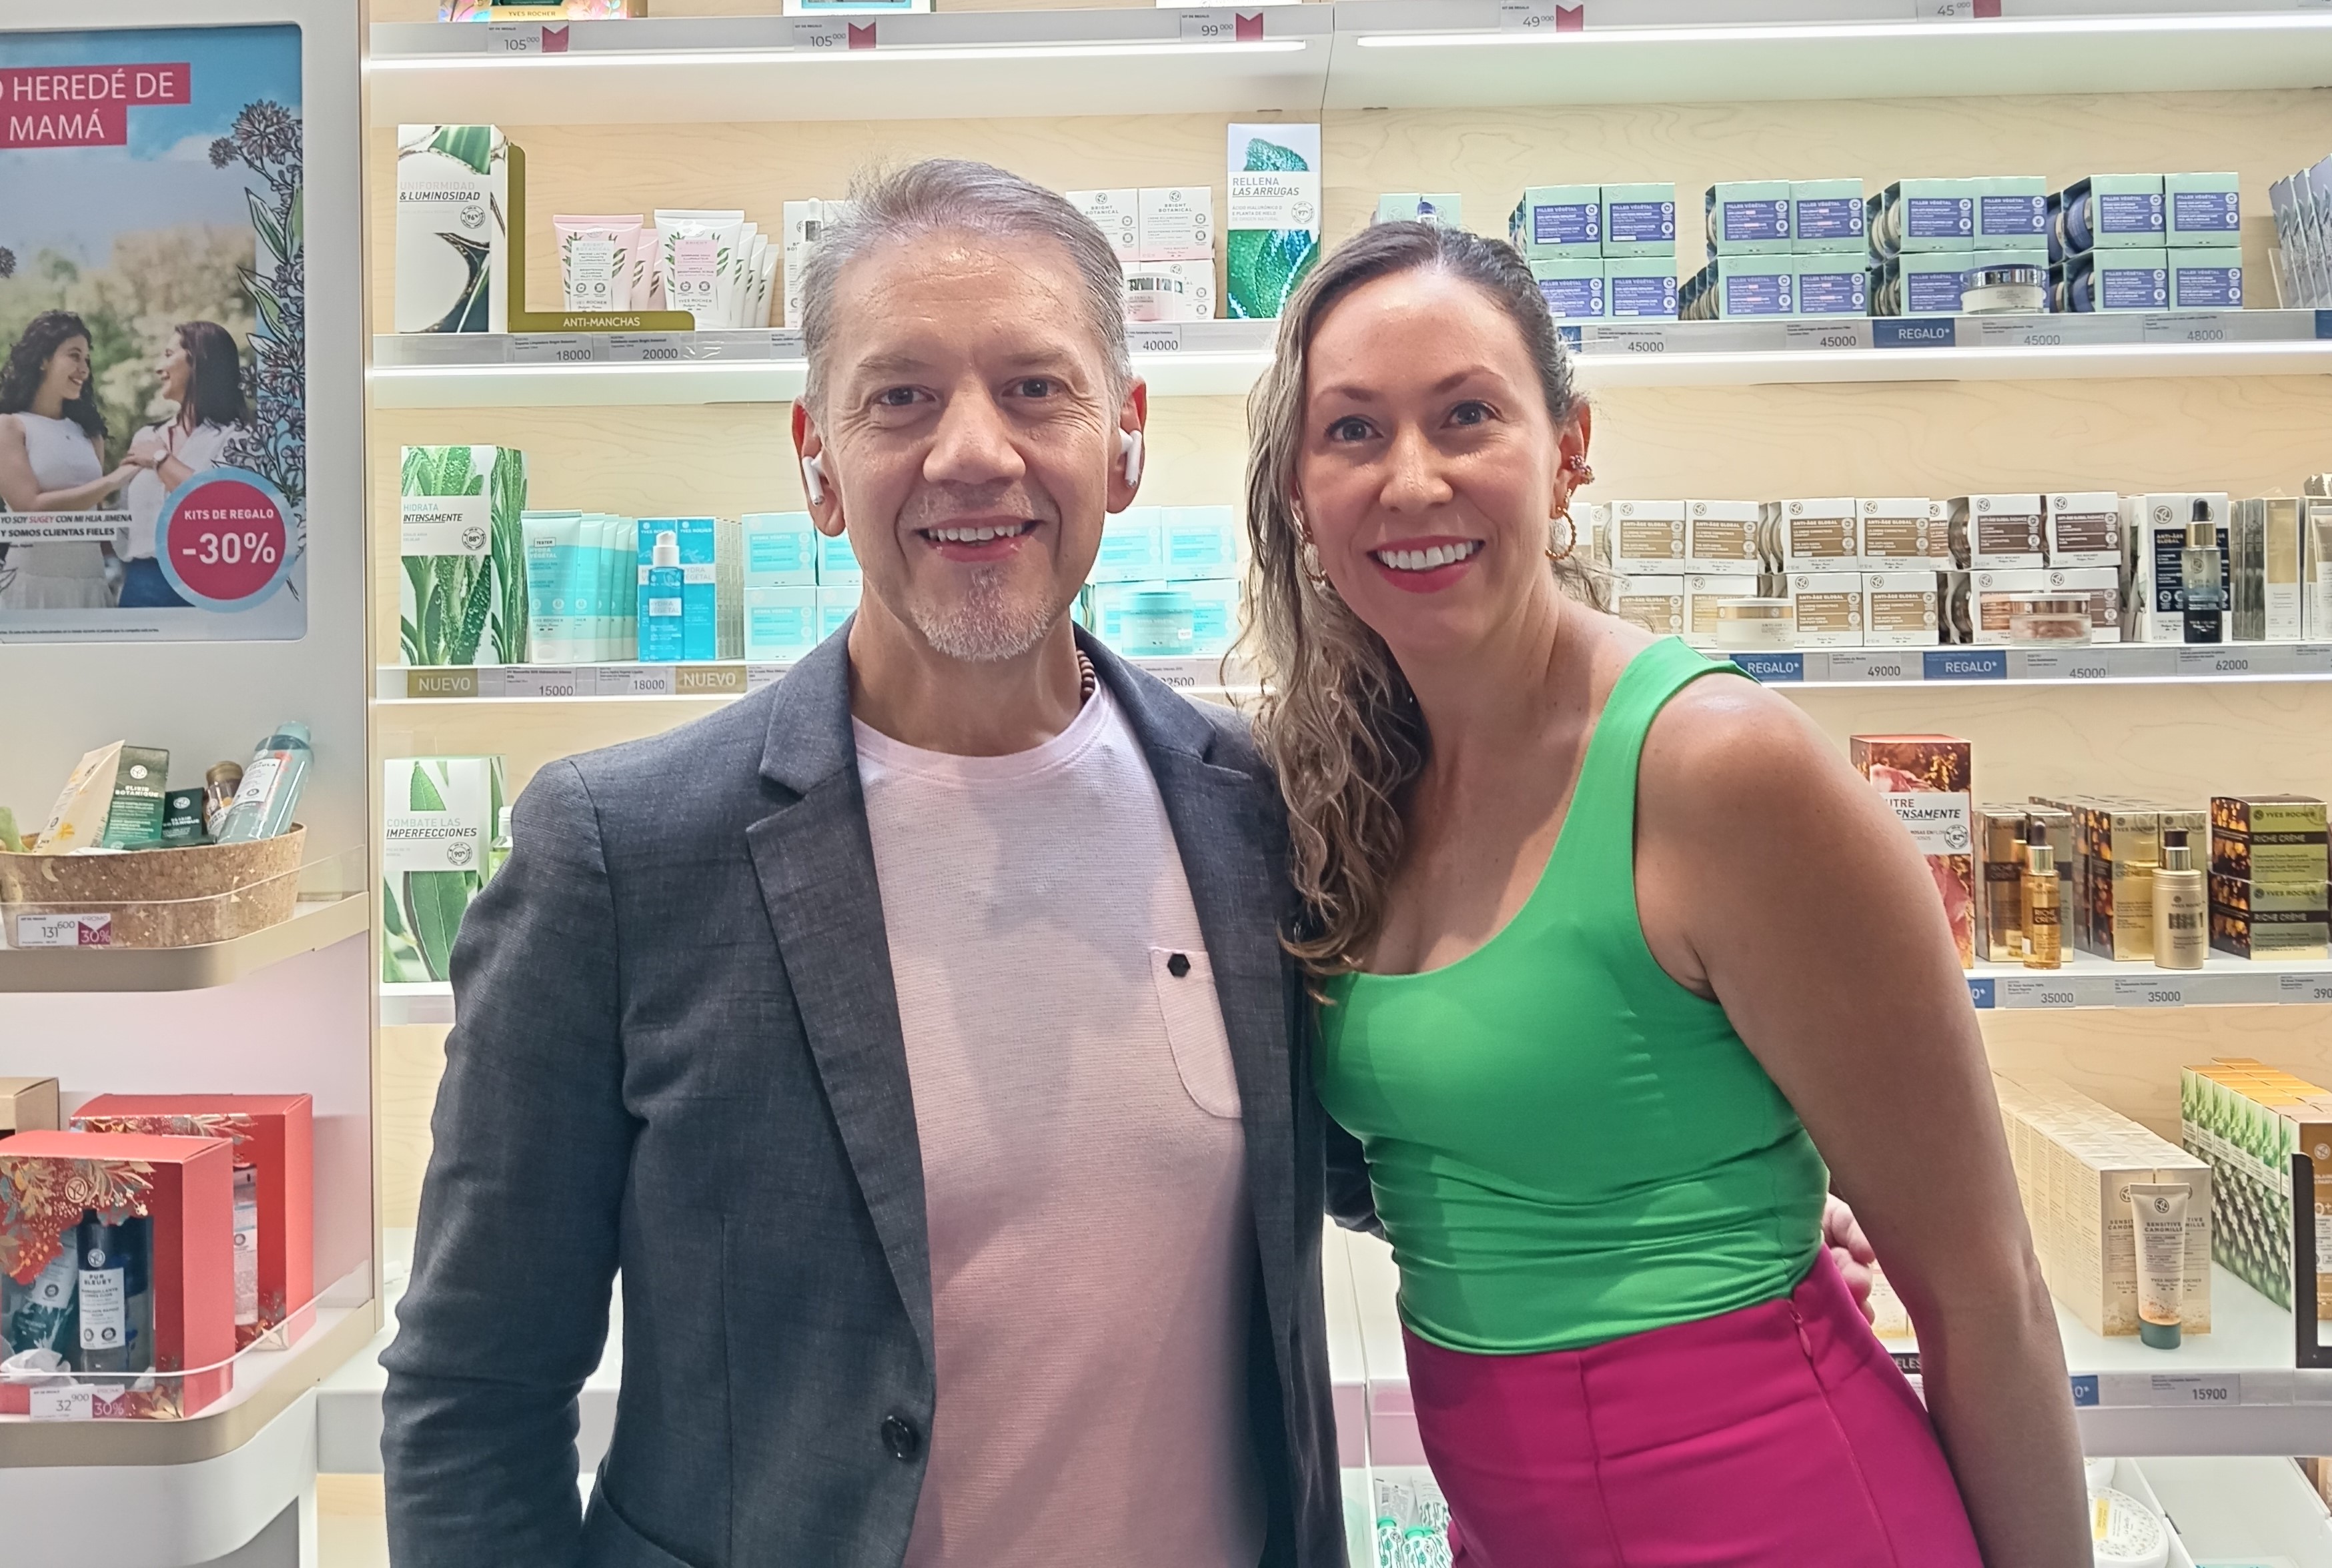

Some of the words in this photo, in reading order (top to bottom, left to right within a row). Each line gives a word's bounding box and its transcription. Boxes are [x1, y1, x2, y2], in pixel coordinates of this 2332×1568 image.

[13, 68, 126, 101] HEREDÉ
[136, 71, 174, 99] DE
[9, 108, 105, 141] MAMÁ
[400, 181, 475, 190] UNIFORMIDAD
[1233, 177, 1279, 186] RELLENA
[400, 191, 407, 200] &
[409, 191, 480, 201] LUMINOSIDAD
[1232, 187, 1251, 195] LAS
[1253, 187, 1299, 195] ARRUGAS
[563, 317, 640, 327] ANTI-MANCHAS
[2024, 335, 2061, 345] 45000
[2187, 329, 2224, 341] 48000
[1143, 340, 1179, 350] 40000
[1628, 341, 1664, 352] 45000
[1820, 336, 1856, 347] 45000
[556, 349, 591, 361] 18000
[642, 348, 678, 359] 20000
[403, 504, 438, 512] HIDRATA
[13, 516, 28, 524] SOY
[29, 515, 55, 524] SUGEY
[55, 515, 73, 523] CON
[103, 514, 133, 522] JIMENA
[184, 510, 209, 521] KITS
[212, 510, 227, 520] DE
[229, 509, 275, 520] REGALO
[403, 514, 463, 522] INTENSAMENTE
[8, 529, 41, 538] SOMOS
[43, 528, 85, 536] CLIENTAS
[86, 528, 115, 536] FIELES
[182, 532, 276, 565] -30%
[2216, 660, 2248, 670] 62000
[1868, 666, 1900, 676] 49000
[2070, 668, 2106, 678] 45000
[419, 677, 470, 691] NUEVO
[684, 672, 736, 686] NUEVO
[634, 680, 664, 690] 18000
[539, 686, 574, 696] 15000
[115, 790, 159, 798] BOTANIQUE
[387, 818, 437, 827] COMBATE
[440, 818, 460, 827] LAS
[386, 828, 478, 838] IMPERFECCIONES
[2254, 834, 2278, 843] RICHE
[2254, 913, 2279, 921] RICHE
[80, 930, 111, 943] 30%
[2041, 992, 2074, 1003] 35000
[2148, 991, 2181, 1002] 35000
[2192, 1388, 2227, 1400] 15900
[94, 1403, 124, 1415] 30%
